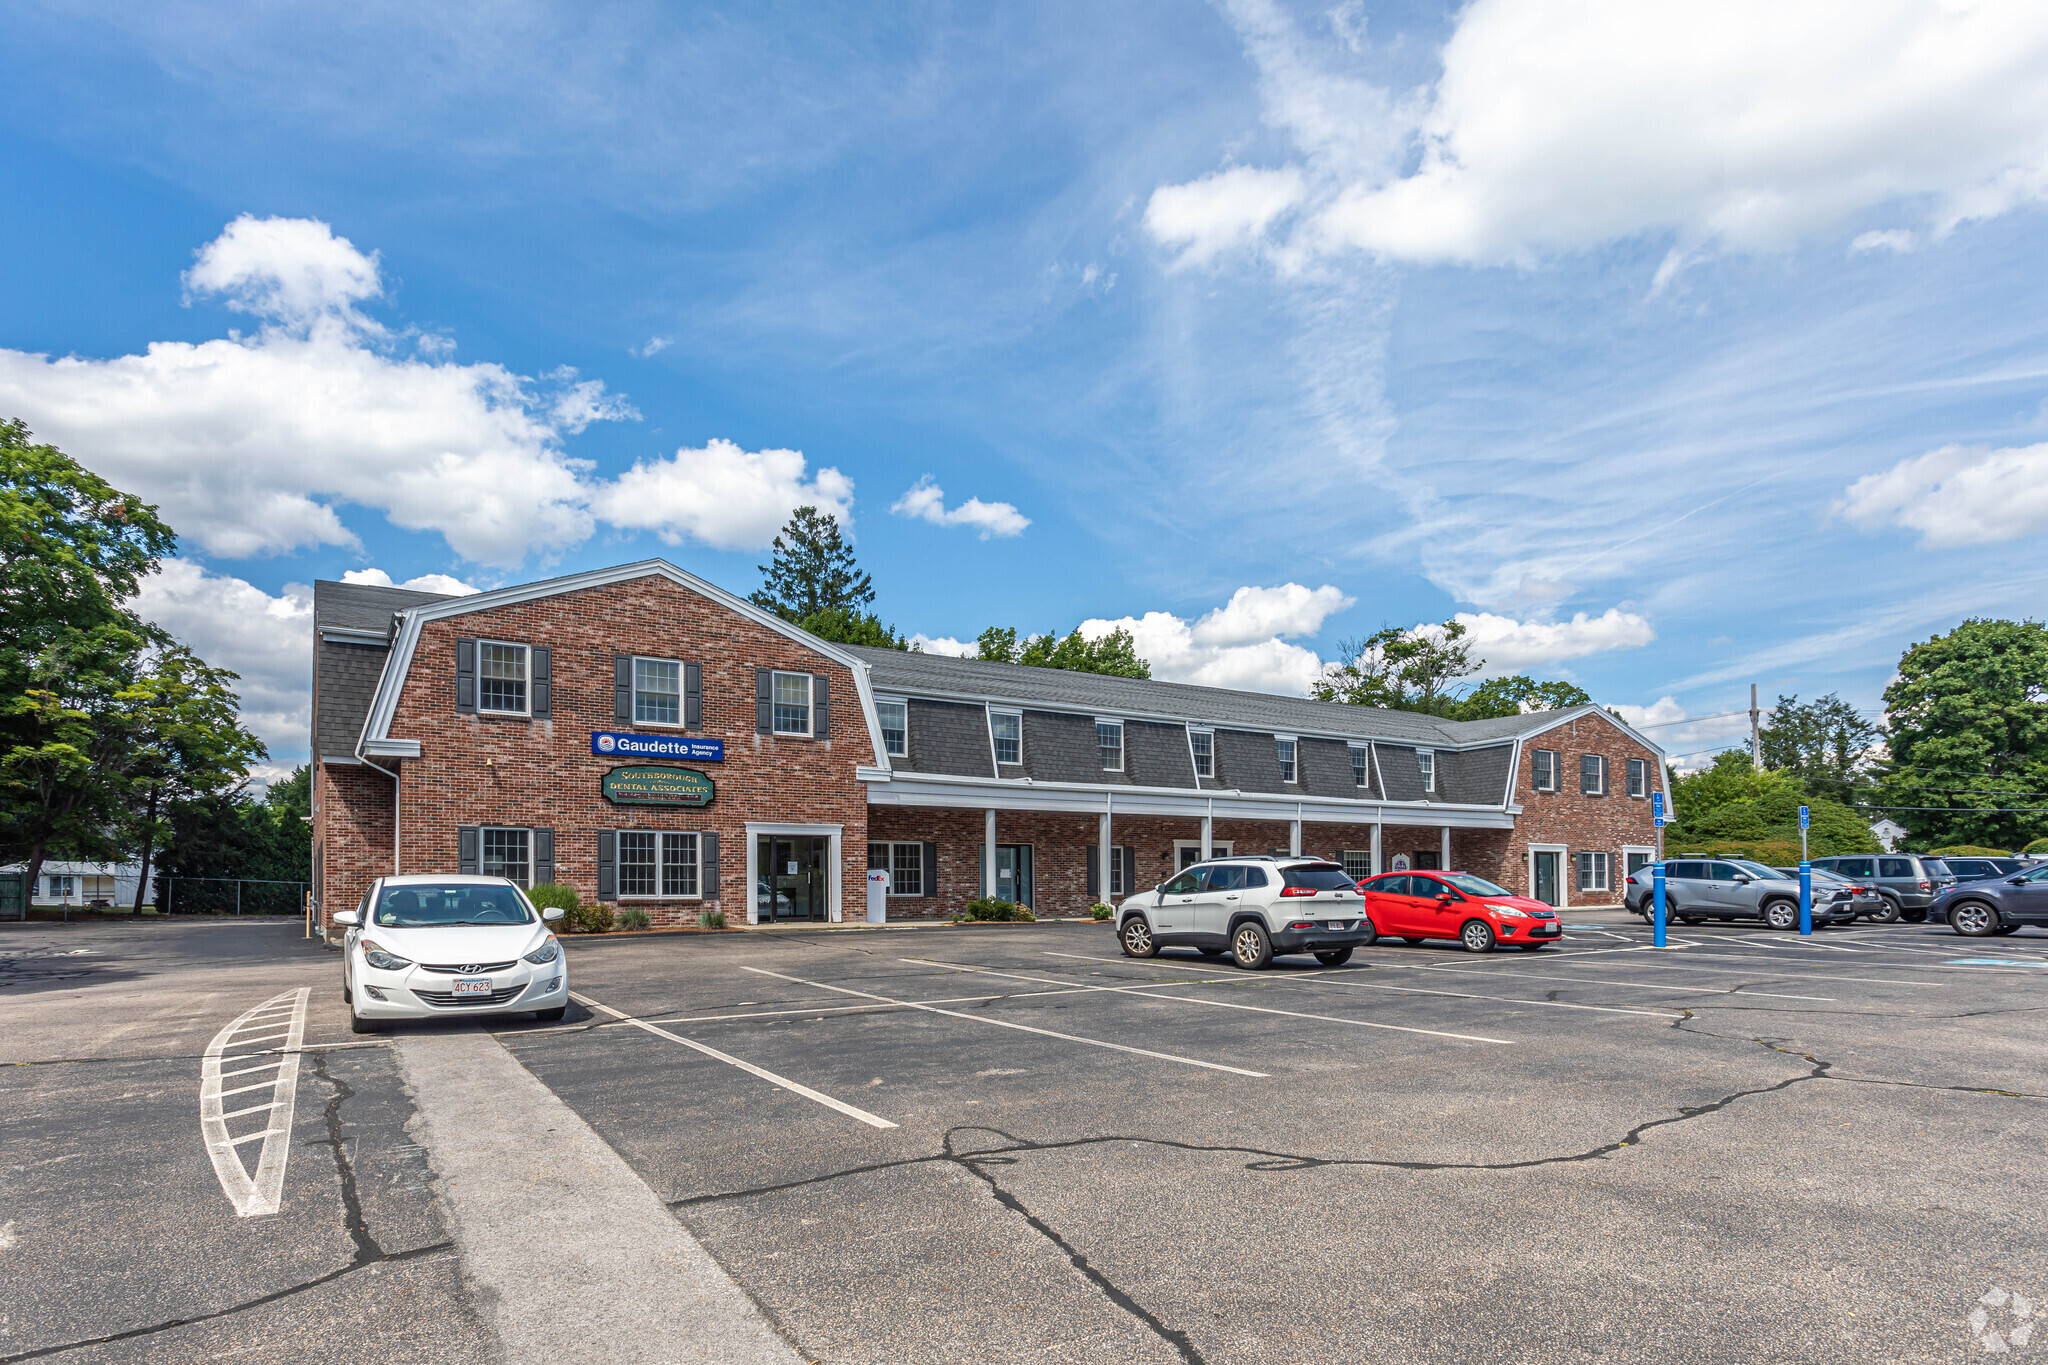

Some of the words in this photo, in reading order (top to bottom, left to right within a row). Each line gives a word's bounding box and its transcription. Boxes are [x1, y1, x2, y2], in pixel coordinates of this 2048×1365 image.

[617, 738, 689, 755] Gaudette
[691, 743, 719, 751] Insurance
[610, 782, 648, 791] DENTAL
[651, 784, 708, 793] ASSOCIATES
[868, 874, 885, 882] FedEx
[454, 982, 471, 992] 4CY
[473, 982, 490, 992] 623
